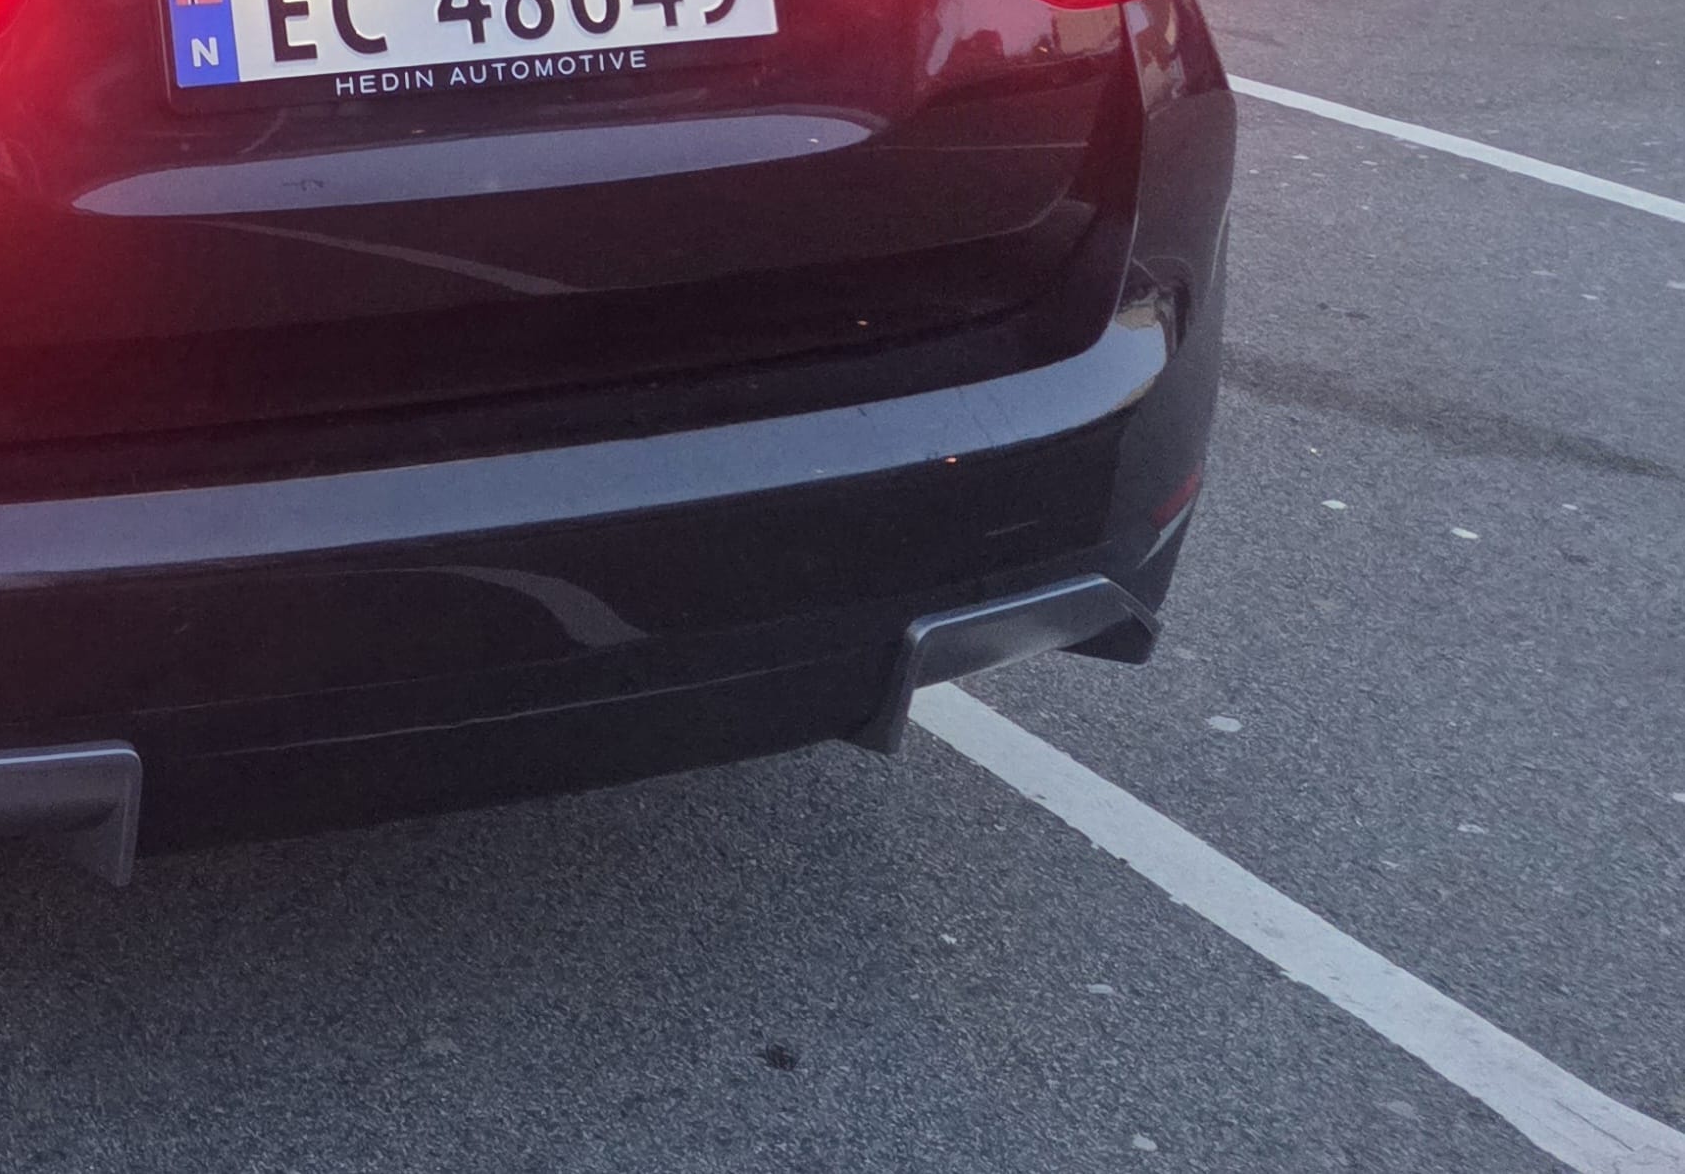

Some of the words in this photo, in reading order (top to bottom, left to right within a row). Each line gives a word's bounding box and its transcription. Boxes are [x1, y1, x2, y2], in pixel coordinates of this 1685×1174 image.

[190, 36, 220, 68] N
[335, 68, 434, 97] HEDIN
[449, 49, 648, 86] AUTOMOTIVE
